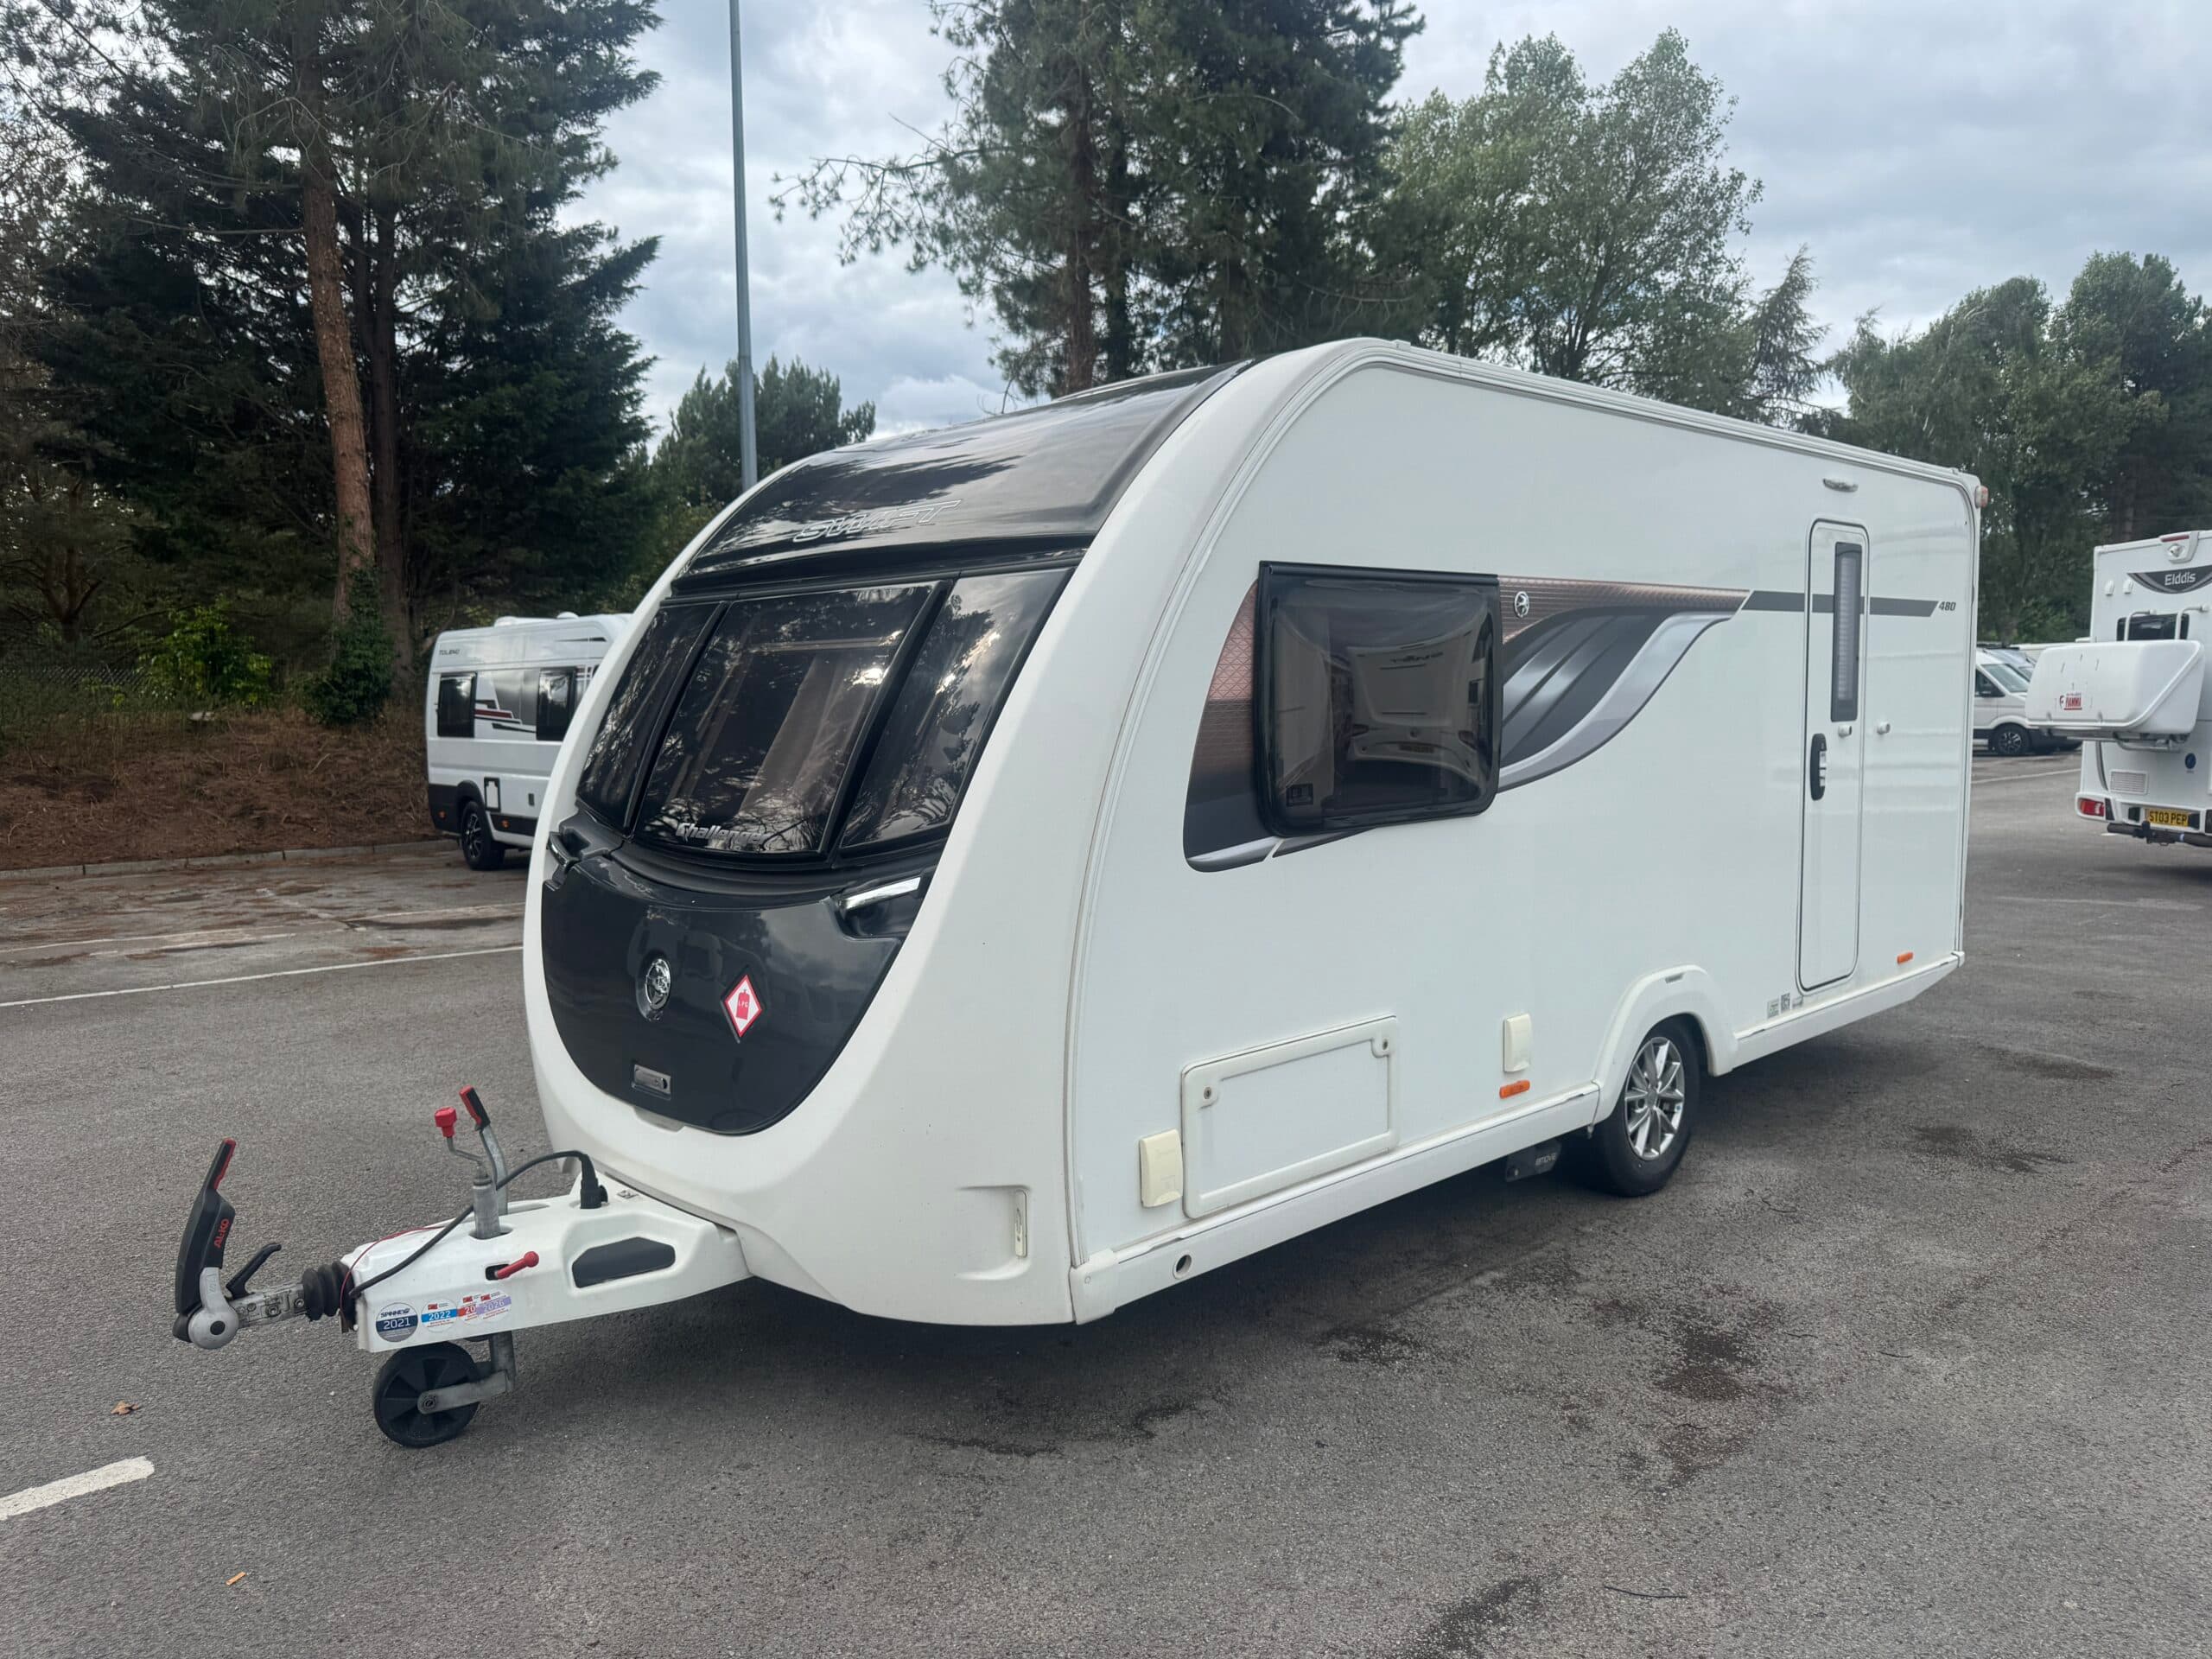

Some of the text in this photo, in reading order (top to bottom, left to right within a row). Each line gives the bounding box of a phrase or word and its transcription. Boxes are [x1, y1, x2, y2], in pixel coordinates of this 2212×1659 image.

[2164, 571, 2196, 586] Elddis
[1939, 601, 1956, 611] 480
[676, 822, 775, 847] Challenger
[428, 1310, 451, 1321] 2022
[383, 1317, 411, 1330] 2021
